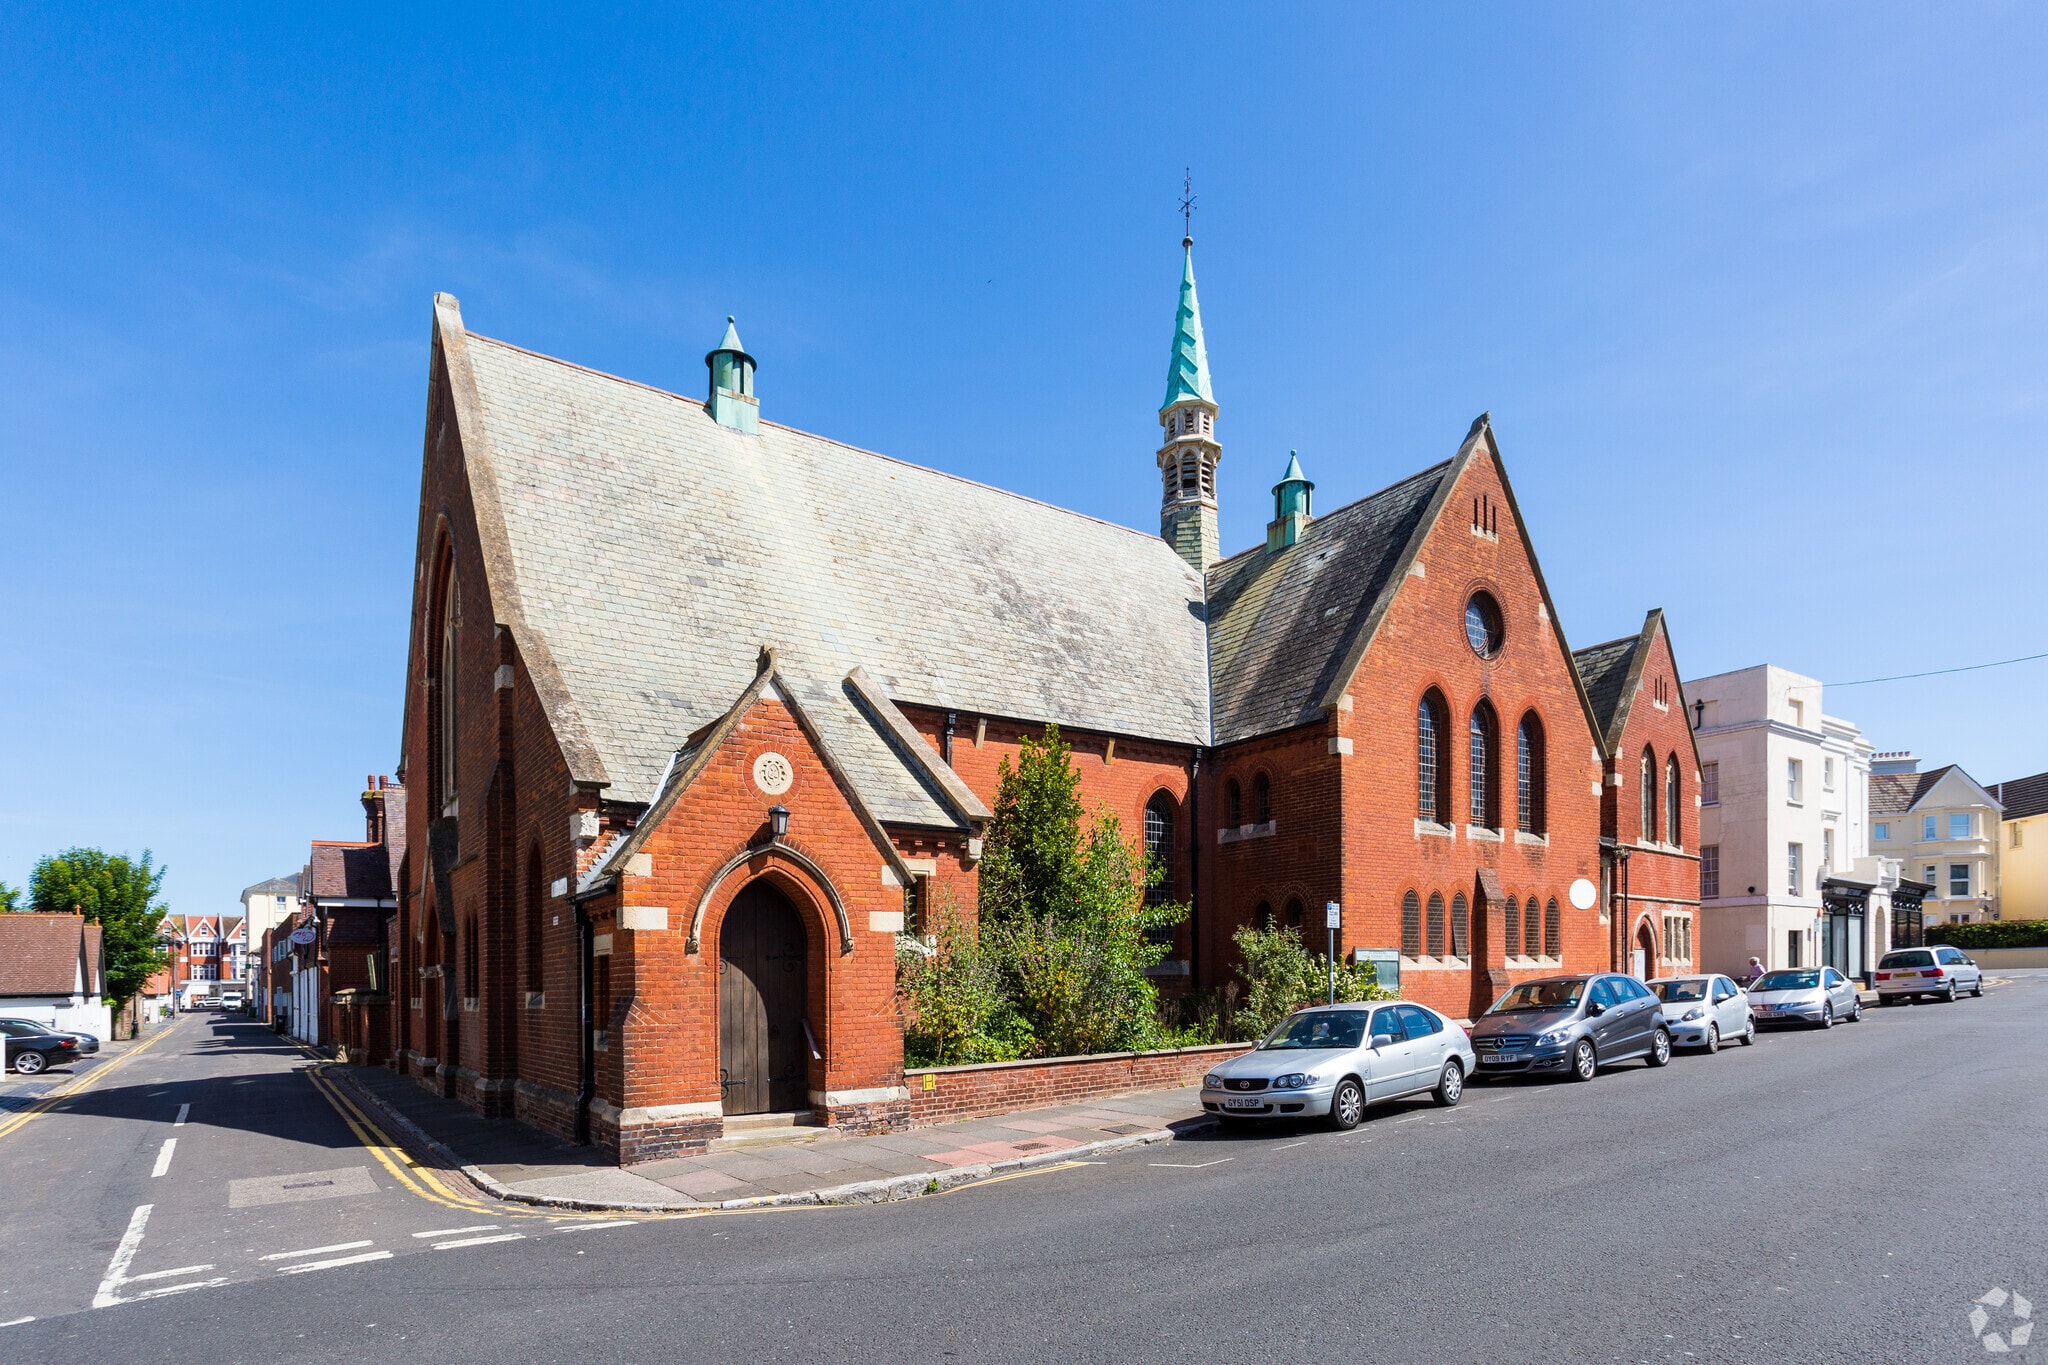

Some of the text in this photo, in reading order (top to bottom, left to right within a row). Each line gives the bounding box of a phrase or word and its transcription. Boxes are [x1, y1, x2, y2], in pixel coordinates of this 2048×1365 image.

[1500, 1054, 1514, 1062] RYF
[924, 1074, 934, 1088] H
[1228, 1098, 1259, 1107] GY51 OSP
